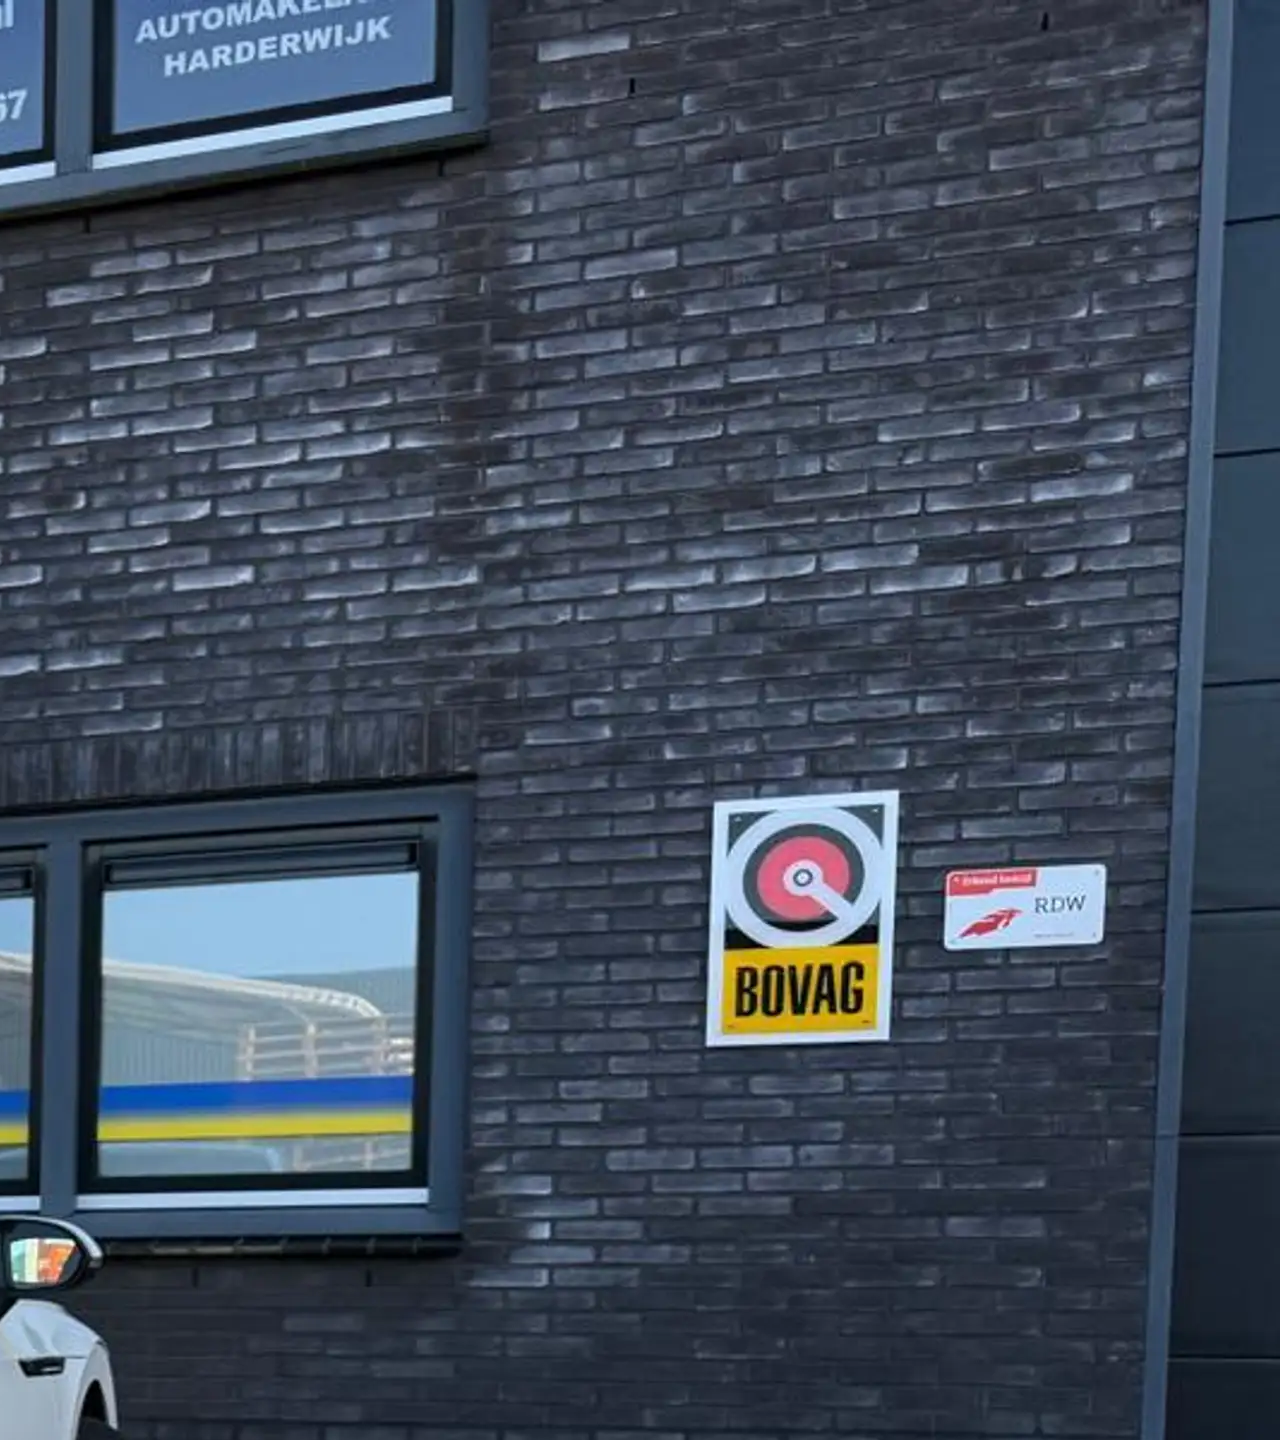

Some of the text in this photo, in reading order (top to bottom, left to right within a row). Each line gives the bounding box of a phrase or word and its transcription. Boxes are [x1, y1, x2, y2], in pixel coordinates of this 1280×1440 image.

[164, 15, 391, 77] HARDERWIJK
[1035, 895, 1086, 914] RDW
[735, 961, 864, 1017] BOVAG
